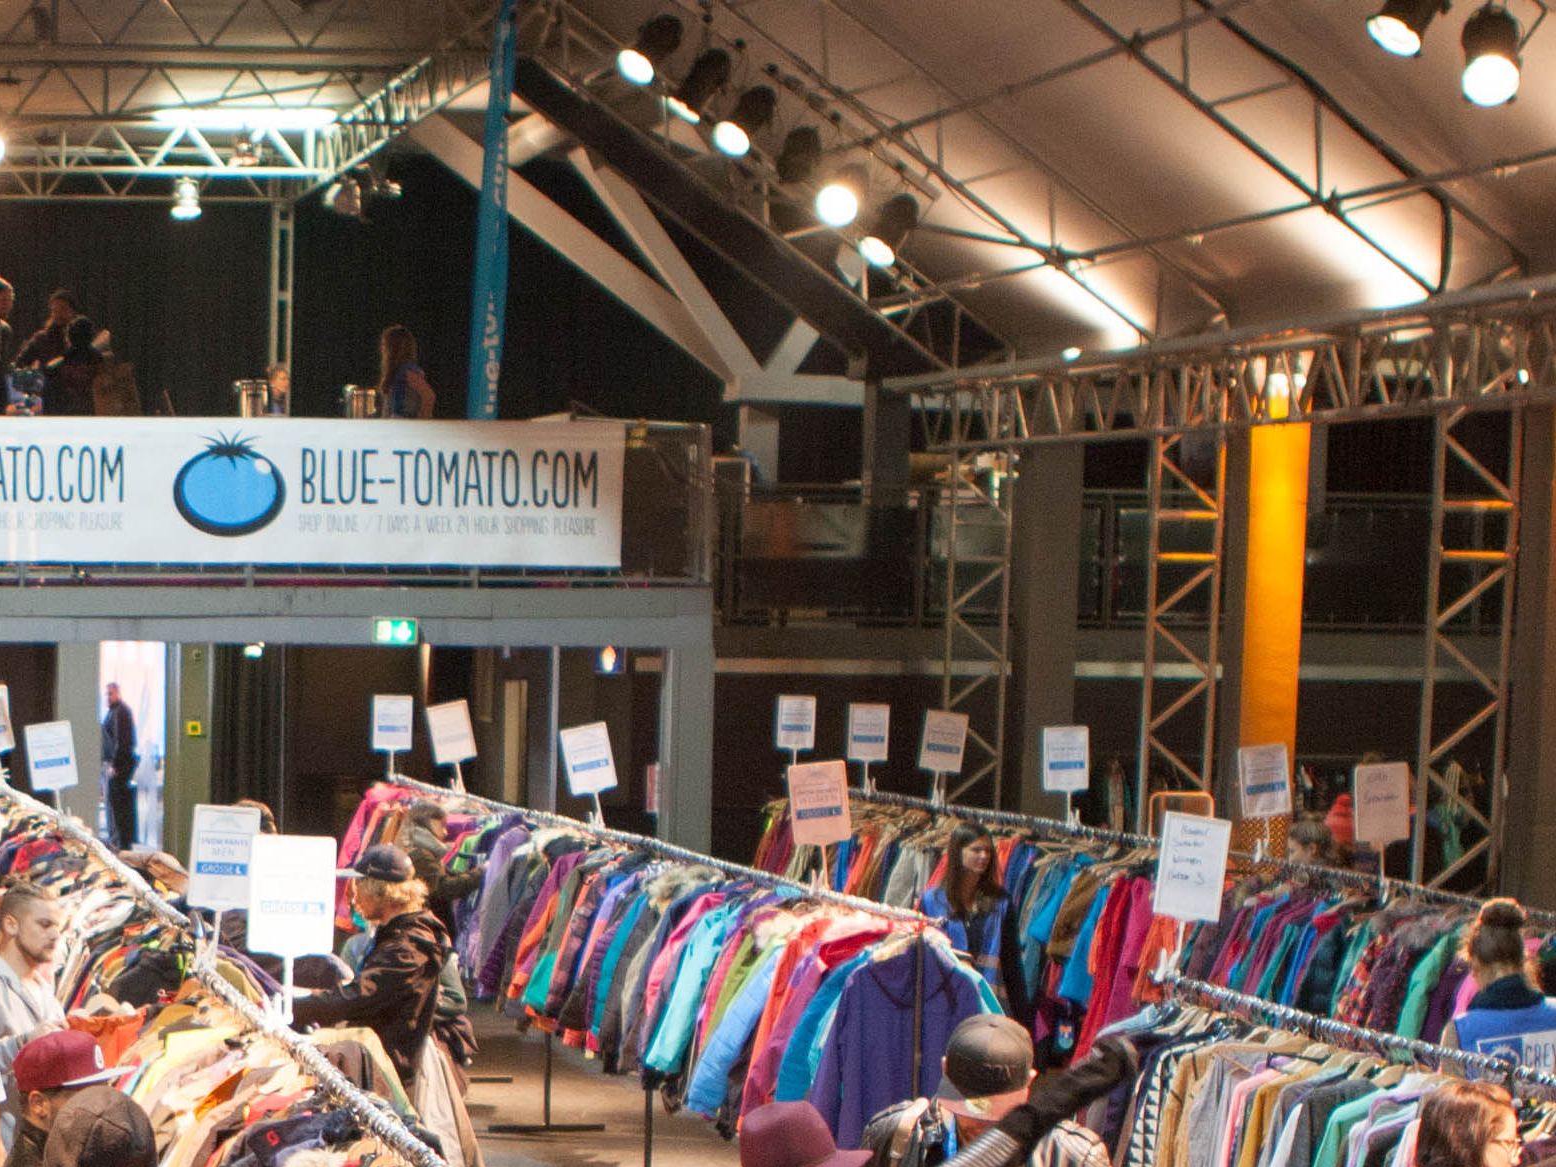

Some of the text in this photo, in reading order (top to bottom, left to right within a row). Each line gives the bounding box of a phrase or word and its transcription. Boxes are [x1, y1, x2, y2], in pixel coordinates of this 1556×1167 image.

[300, 448, 599, 508] BLUE-TOMATO.COM
[425, 516, 453, 535] WEEK
[504, 518, 548, 536] SHOPPING
[1525, 1042, 1556, 1068] CRE
